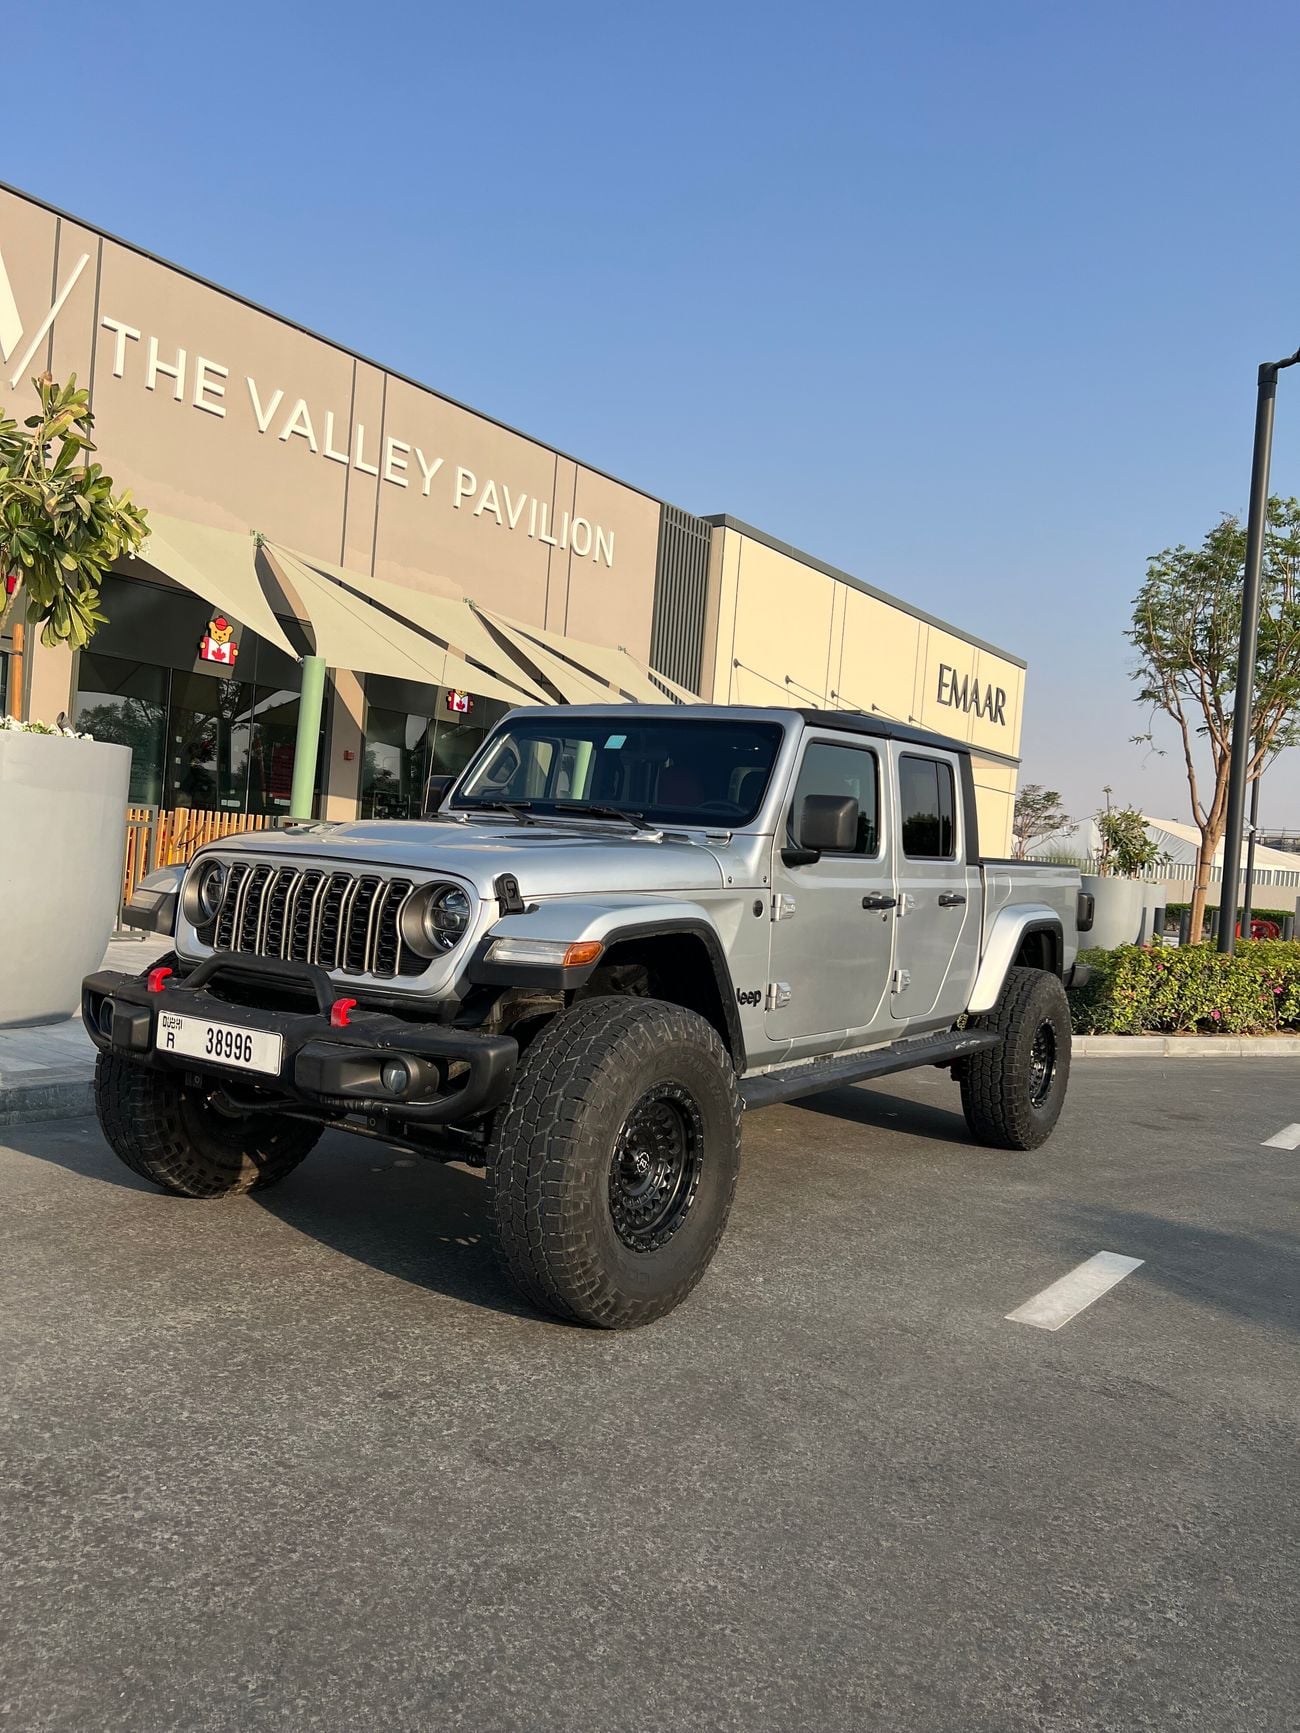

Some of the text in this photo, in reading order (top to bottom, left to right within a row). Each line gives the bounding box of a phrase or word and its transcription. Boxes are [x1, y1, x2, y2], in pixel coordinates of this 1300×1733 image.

[101, 316, 614, 568] THE VALLEY PAVILION
[937, 663, 1006, 726] EMAAR
[736, 987, 762, 1007] Jeep
[166, 1031, 175, 1049] R
[205, 1027, 253, 1062] 38996
